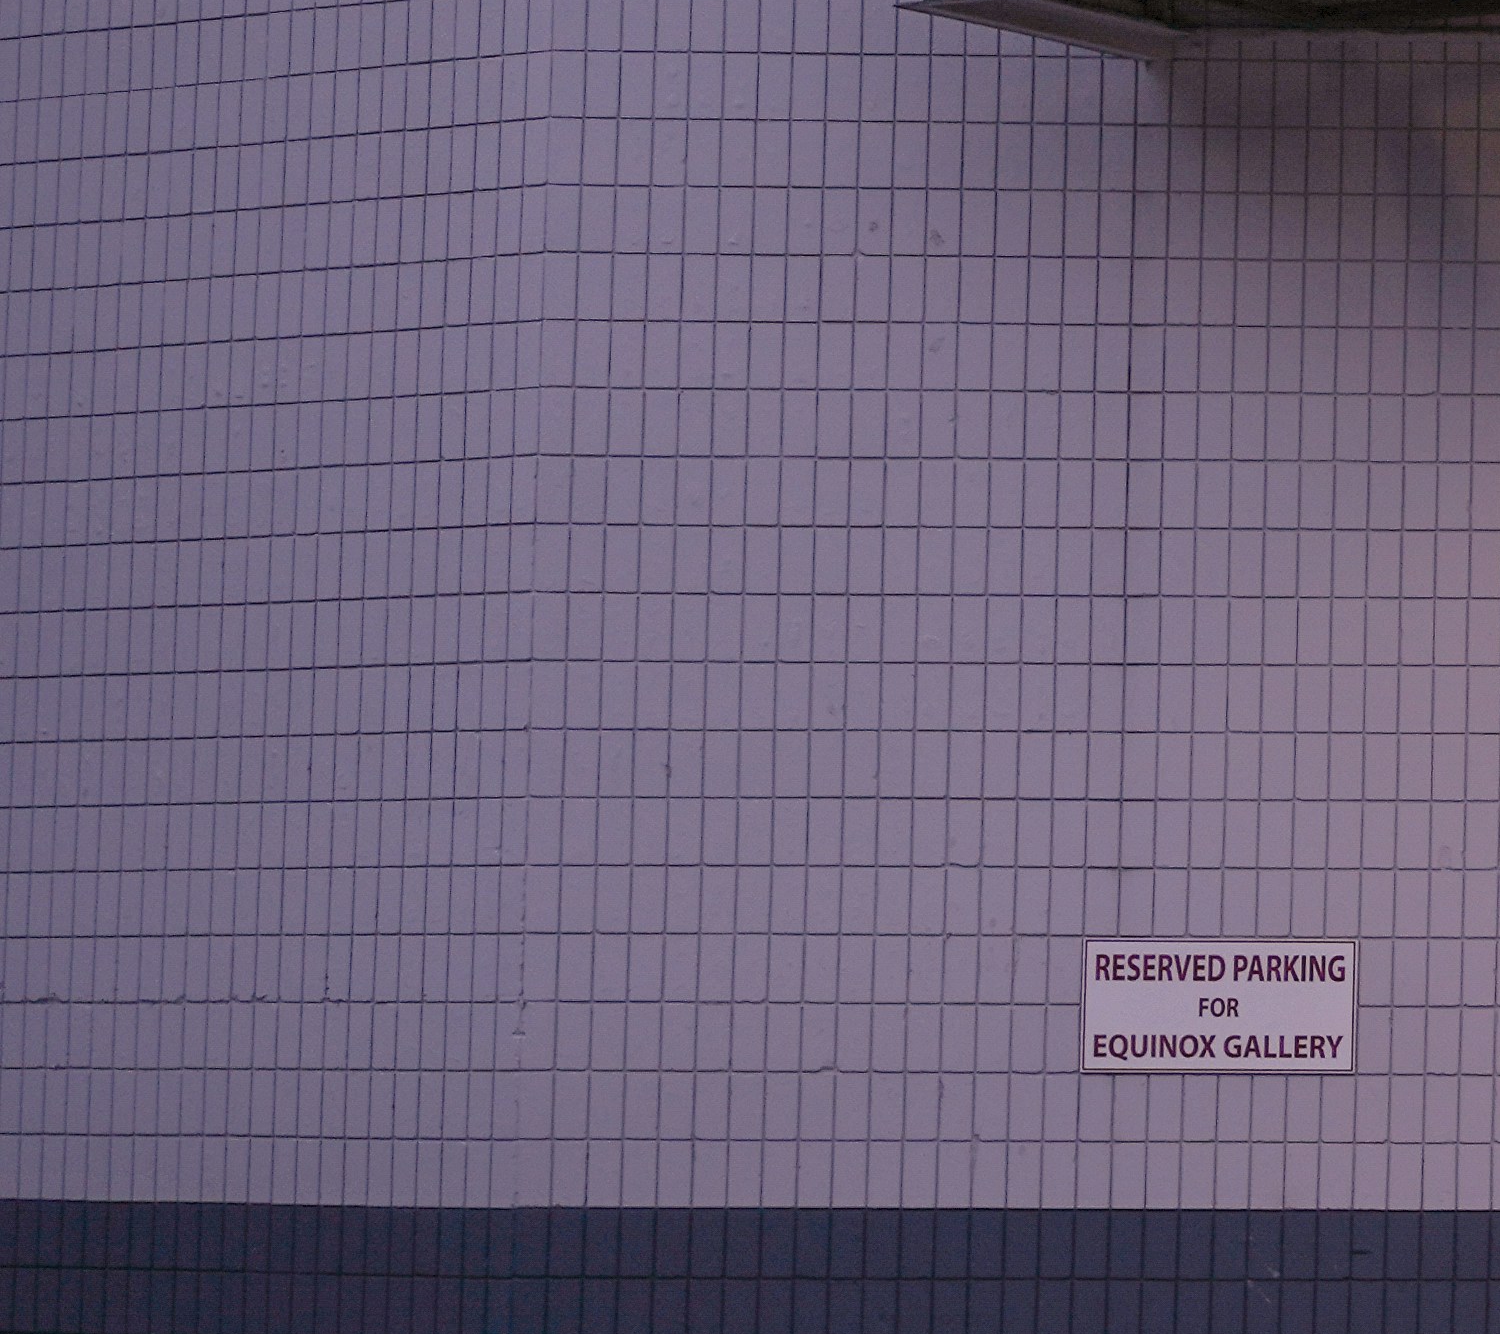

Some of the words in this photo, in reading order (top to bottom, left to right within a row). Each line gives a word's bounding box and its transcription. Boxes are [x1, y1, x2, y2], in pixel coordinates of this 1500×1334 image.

[1095, 953, 1226, 982] RESERVED
[1233, 954, 1346, 983] PARKING
[1198, 997, 1240, 1018] FOR
[1093, 1033, 1217, 1062] EQUINOX
[1223, 1034, 1344, 1059] GALLERY
